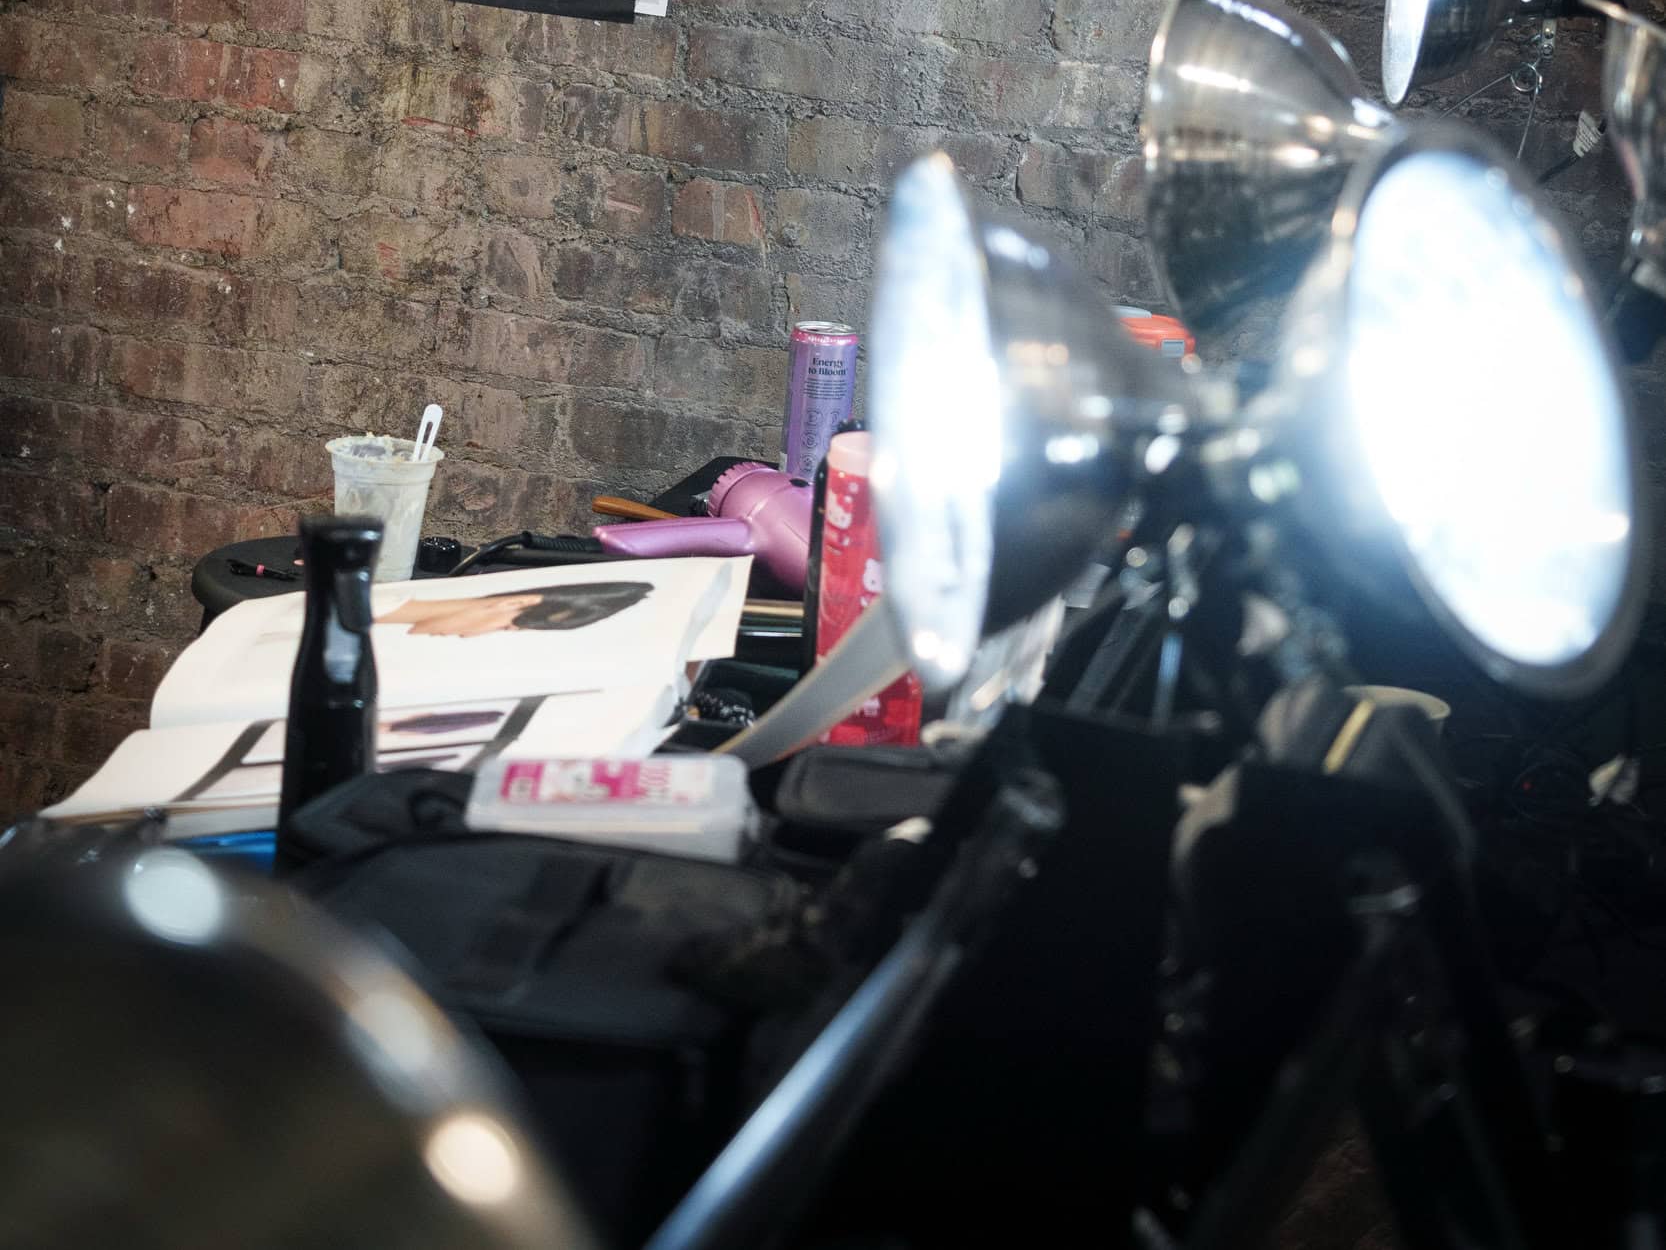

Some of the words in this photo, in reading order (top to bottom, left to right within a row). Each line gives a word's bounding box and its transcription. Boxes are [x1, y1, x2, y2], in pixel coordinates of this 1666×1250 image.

[812, 358, 843, 368] Energy
[808, 367, 817, 375] to
[818, 367, 846, 376] Bloom
